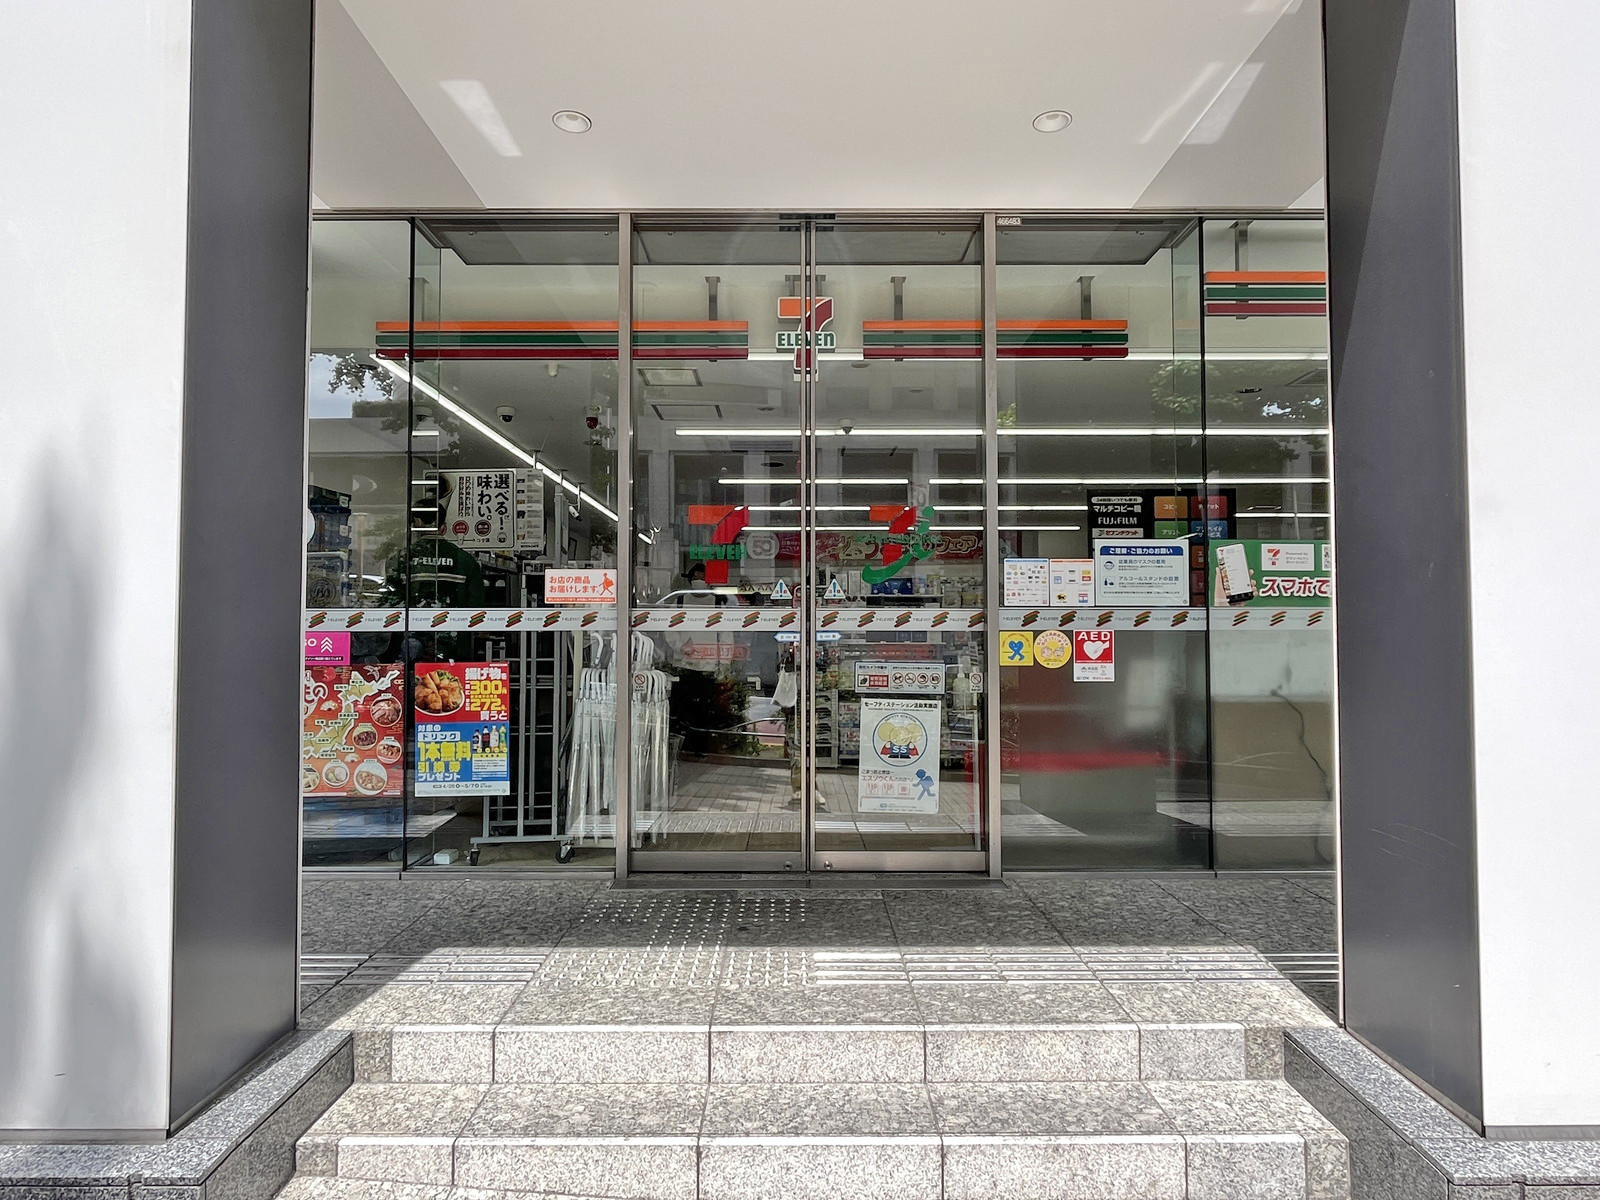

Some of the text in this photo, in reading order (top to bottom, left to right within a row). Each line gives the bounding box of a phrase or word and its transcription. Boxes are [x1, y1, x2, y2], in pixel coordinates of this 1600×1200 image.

[1077, 631, 1111, 641] AED
[417, 772, 461, 782] プレゼント
